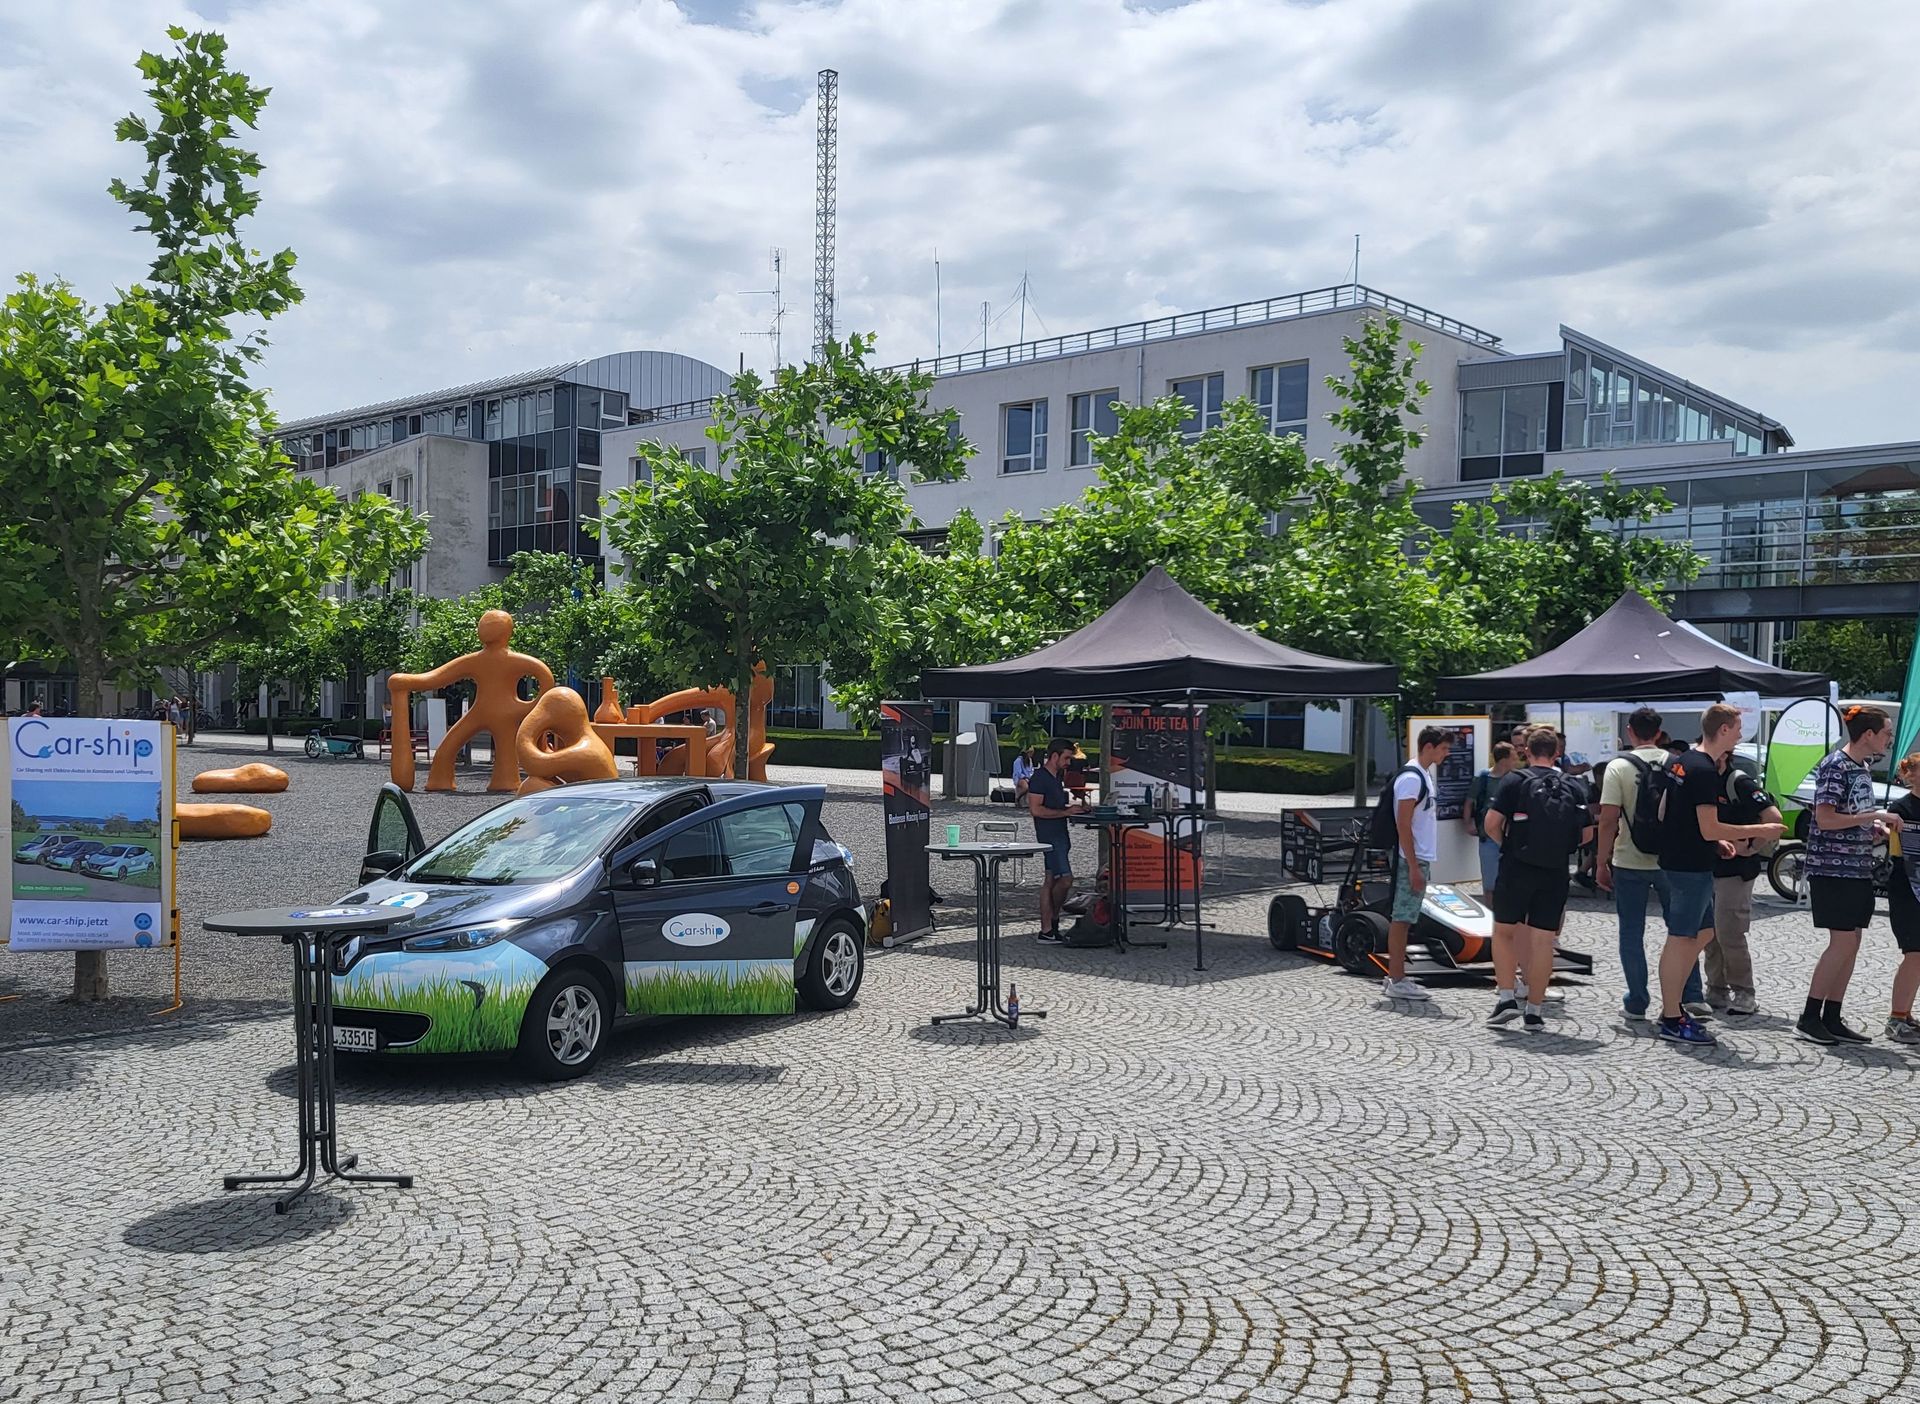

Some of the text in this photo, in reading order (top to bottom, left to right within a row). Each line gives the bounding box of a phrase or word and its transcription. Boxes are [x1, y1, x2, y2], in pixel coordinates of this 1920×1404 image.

[1120, 716, 1144, 730] JOIN
[1147, 716, 1166, 730] THE
[15, 720, 153, 767] Car-ship
[1307, 858, 1318, 879] 43
[19, 916, 109, 928] www.car-ship.jetzt
[669, 921, 724, 939] Car-ship
